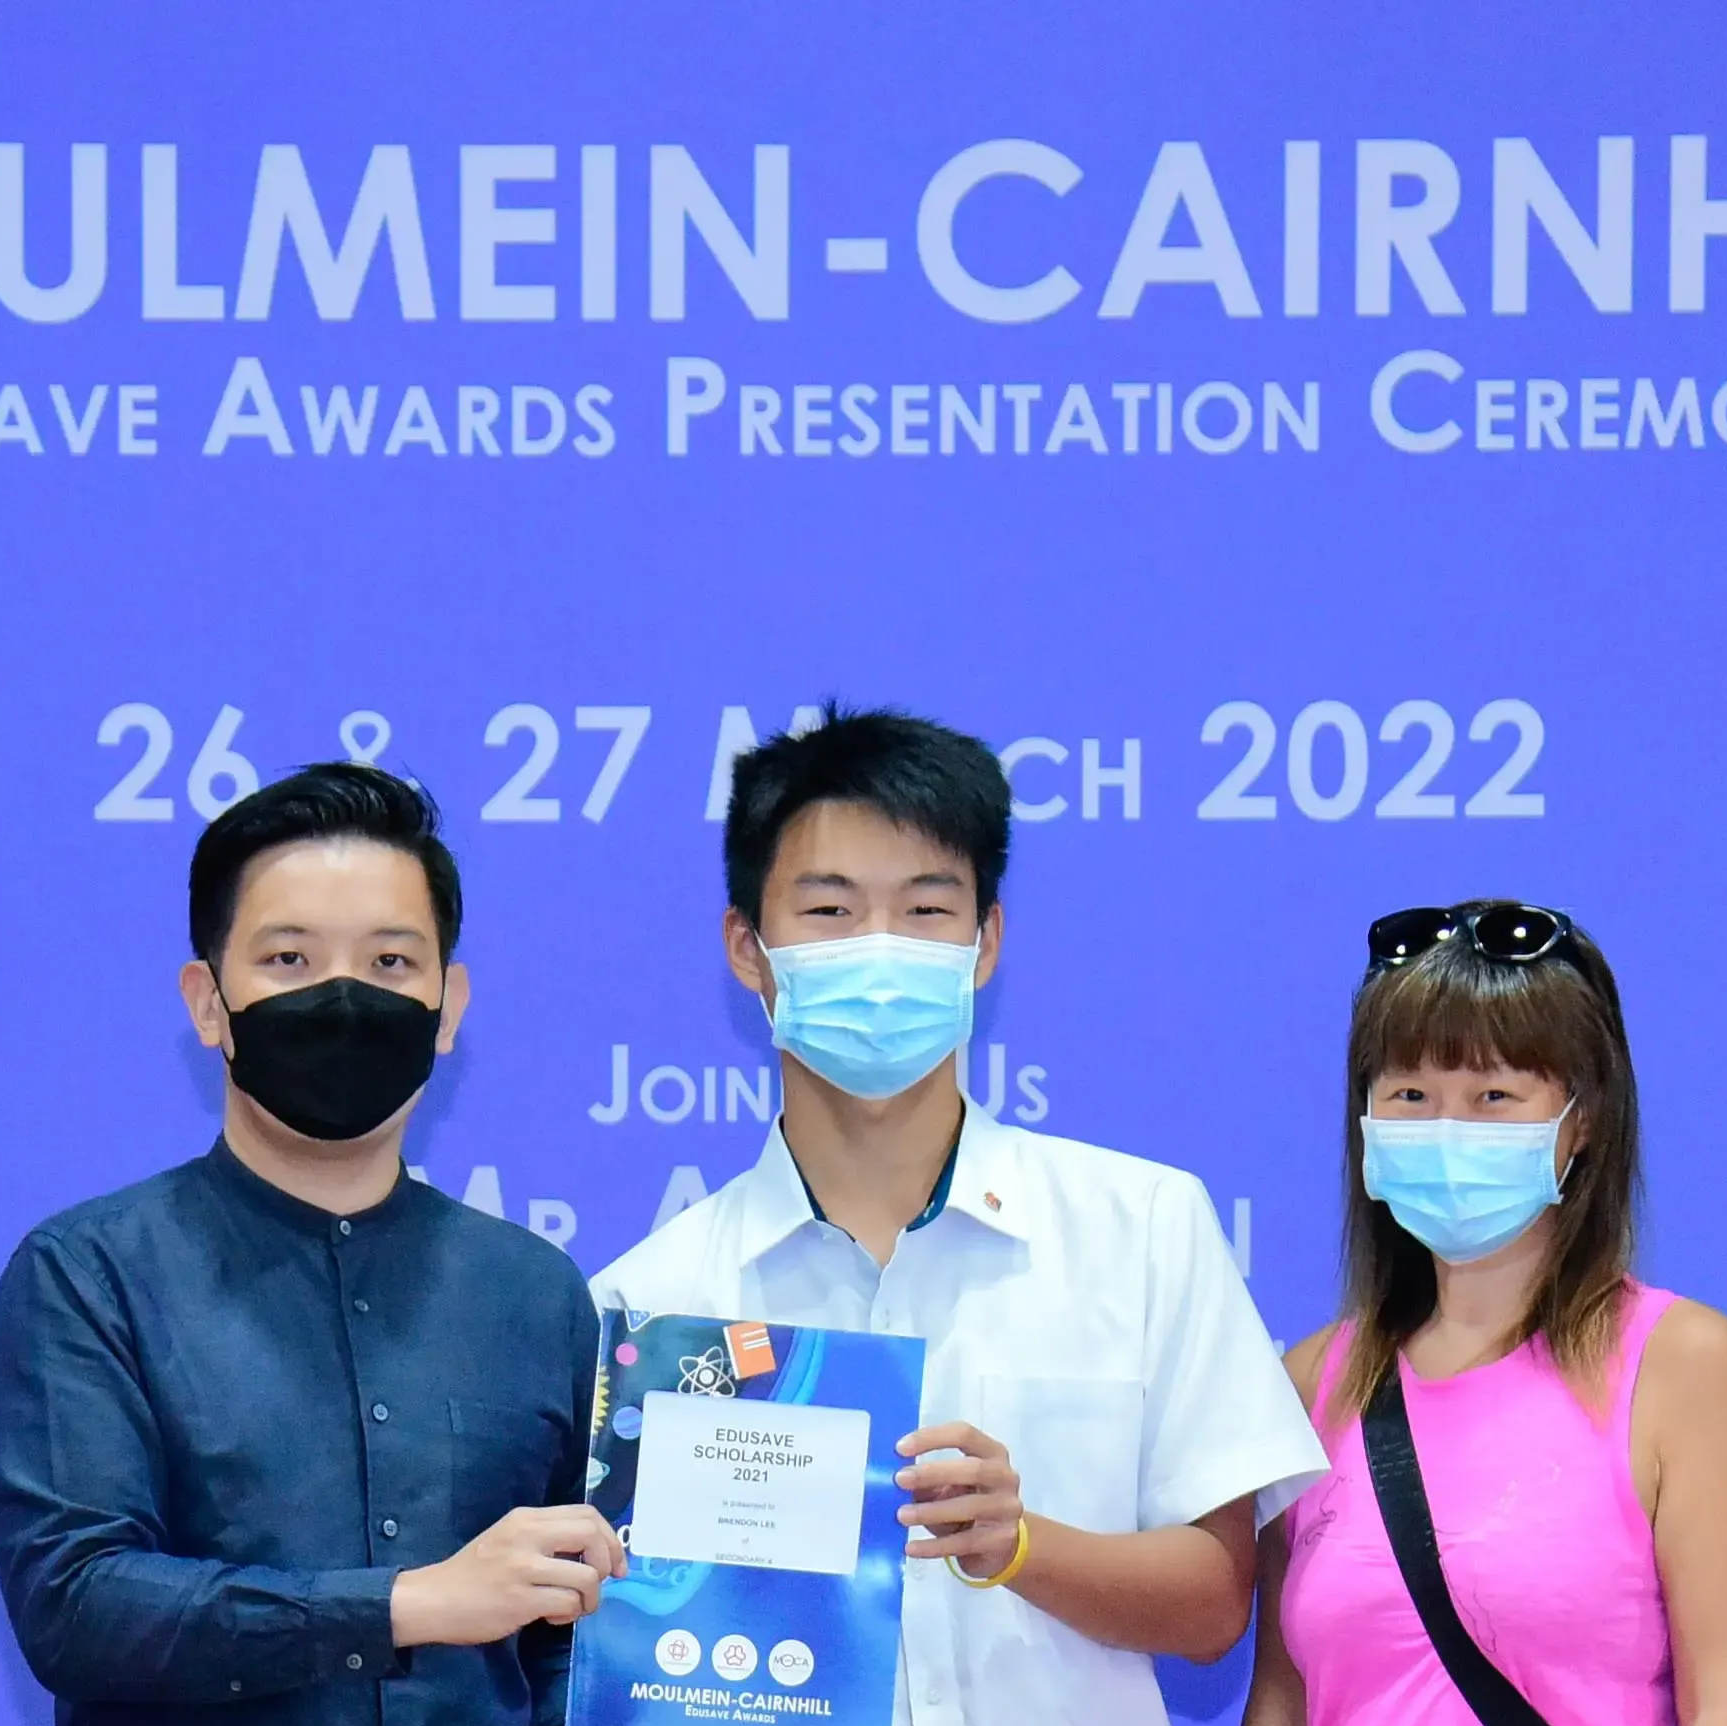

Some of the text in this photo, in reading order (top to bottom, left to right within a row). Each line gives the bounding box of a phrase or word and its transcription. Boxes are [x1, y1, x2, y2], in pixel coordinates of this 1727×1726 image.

[201, 356, 616, 458] AWARDS
[666, 355, 1320, 458] PRESENTATION
[94, 702, 260, 822] 26
[480, 703, 652, 824] 27
[1196, 698, 1546, 822] 2022
[715, 1428, 795, 1448] EDUSAVE
[694, 1445, 813, 1468] SCHOLARSHIP
[733, 1467, 769, 1483] 2021
[630, 1682, 832, 1716] MOULMEIN-CAIRNHILL
[685, 1704, 776, 1725] EDUSAVE AWARDS
